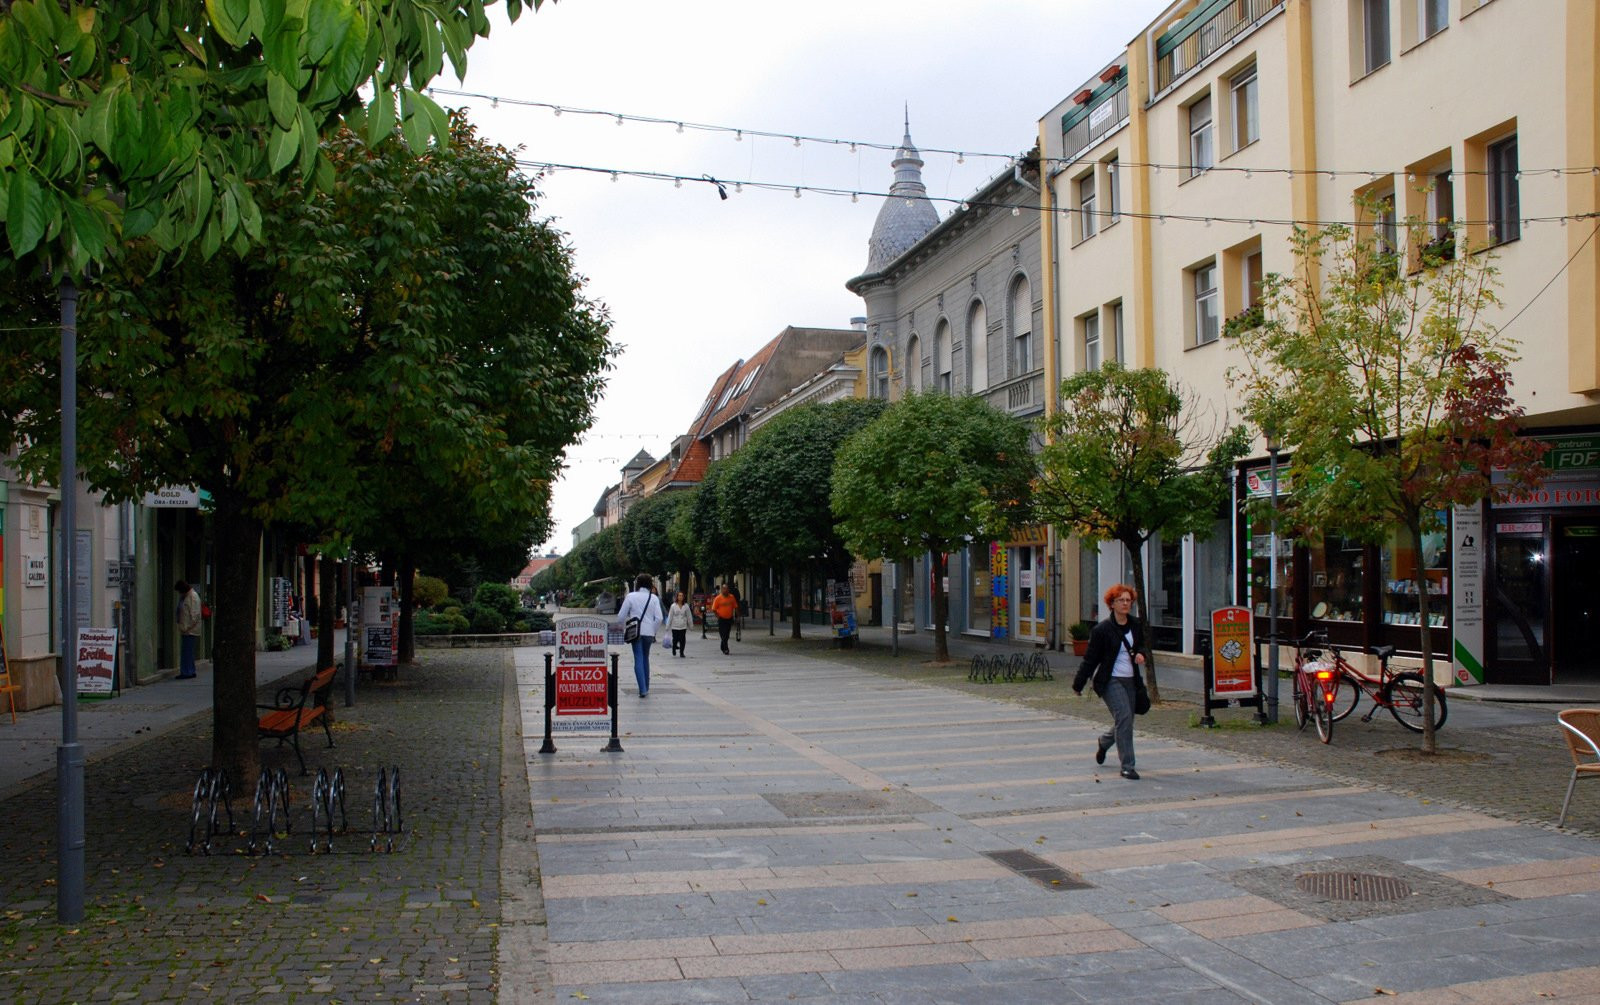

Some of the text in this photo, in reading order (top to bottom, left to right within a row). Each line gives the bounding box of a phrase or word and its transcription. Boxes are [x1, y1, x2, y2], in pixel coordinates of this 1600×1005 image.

[1557, 440, 1593, 448] entrum
[560, 630, 604, 645] Erotikus
[558, 646, 605, 660] Panoptikum
[561, 667, 603, 681] KÍNZÓ
[559, 683, 605, 692] FOLTER-TORTURE
